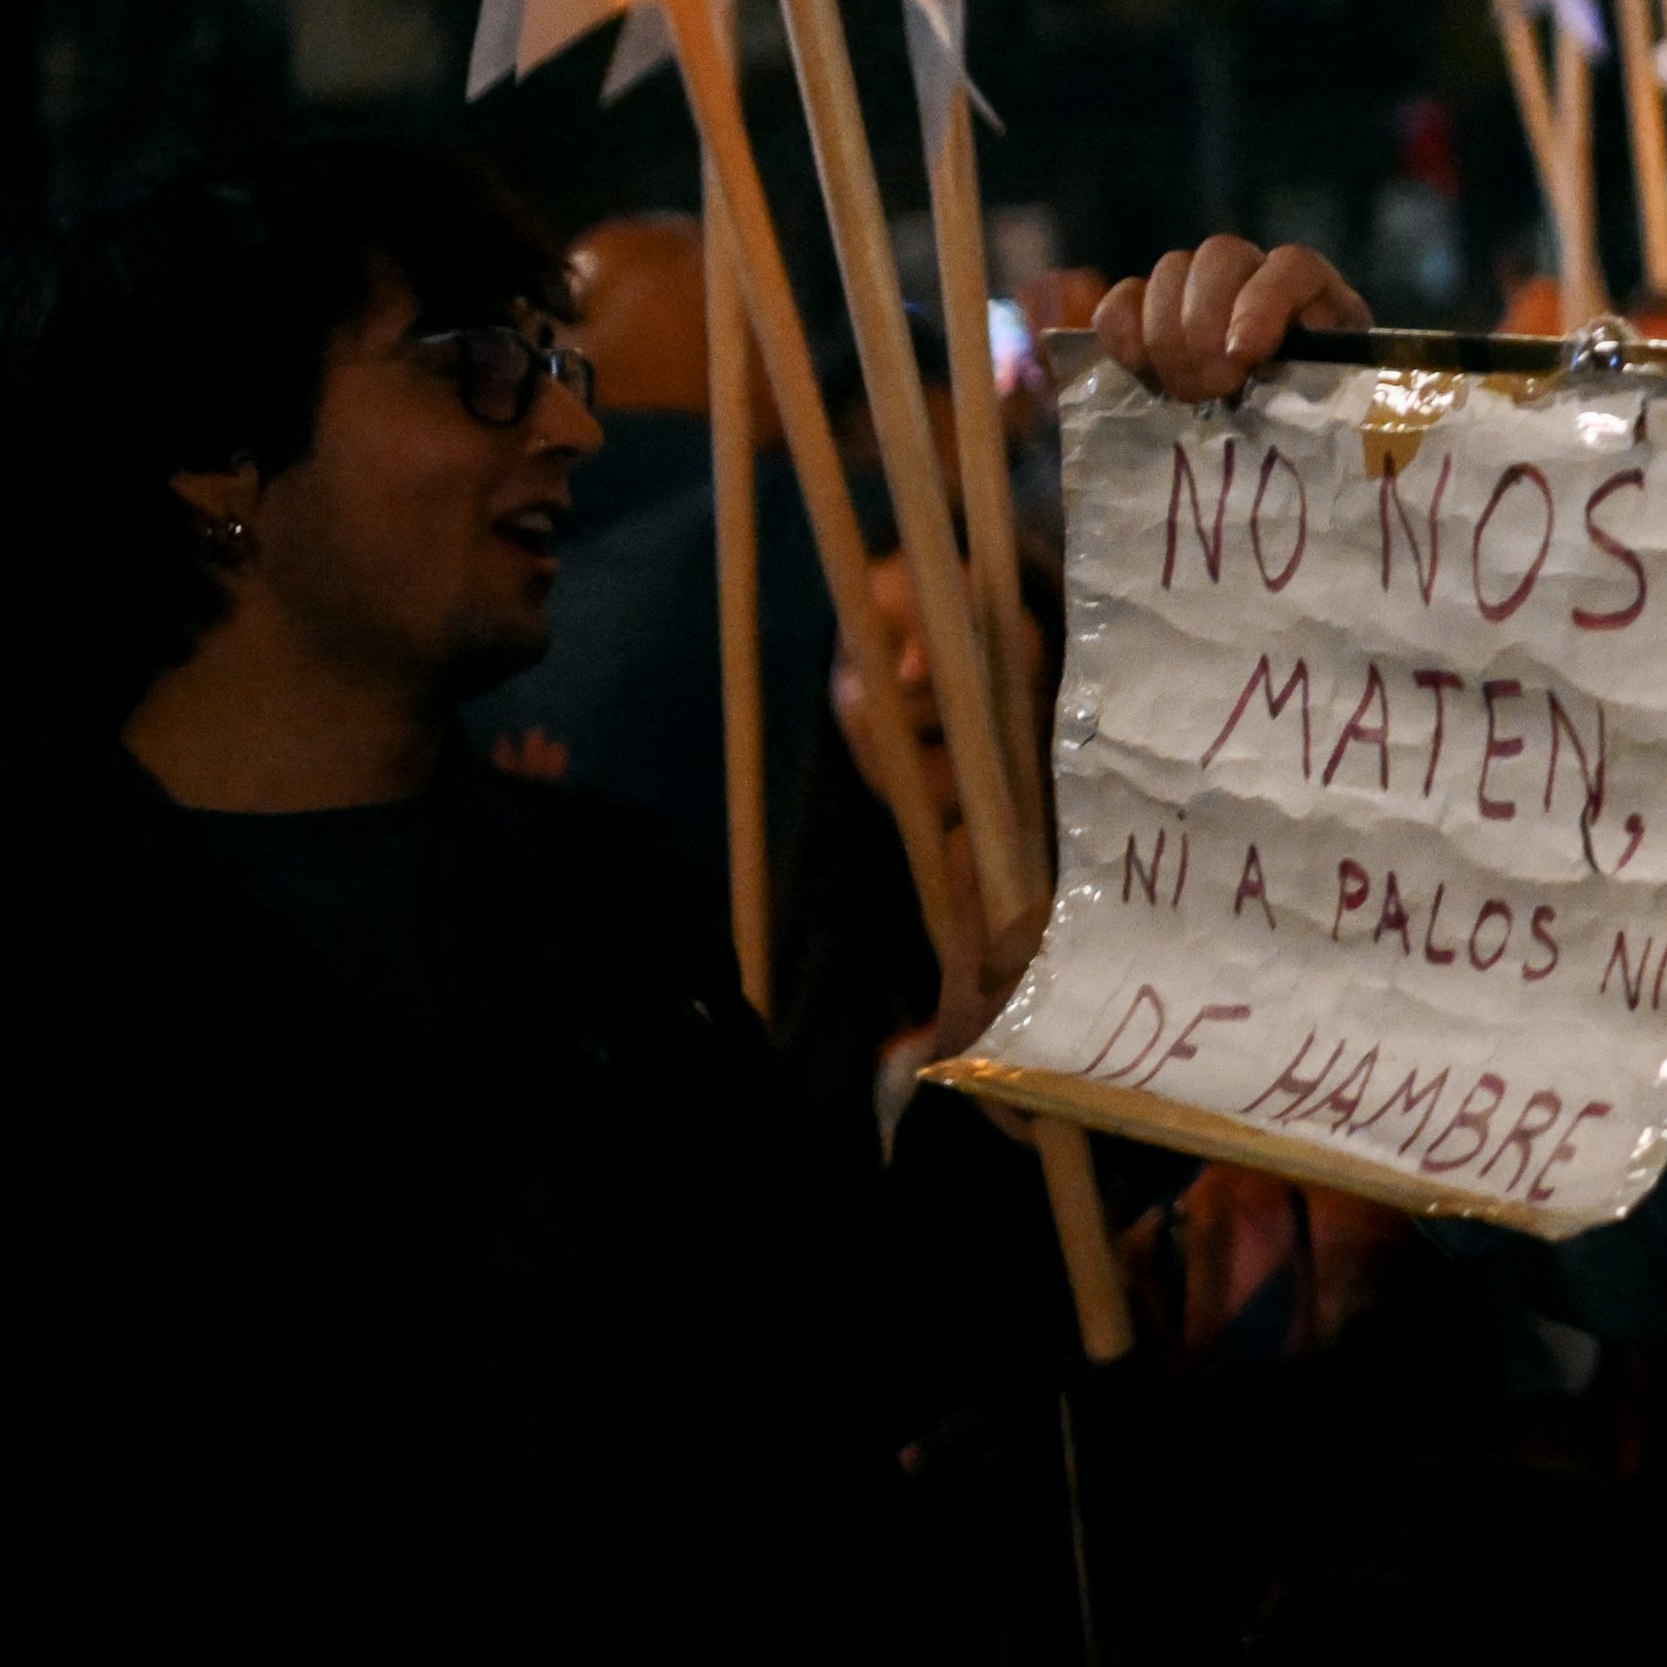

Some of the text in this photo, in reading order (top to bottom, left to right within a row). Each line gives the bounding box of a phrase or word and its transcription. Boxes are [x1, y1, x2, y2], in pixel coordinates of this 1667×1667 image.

[1162, 438, 1648, 631] NO NOS
[1201, 654, 1644, 872] MATEN,
[1234, 845, 1275, 929] A
[1332, 858, 1560, 982] PALOS
[1238, 1029, 1612, 1202] HAMBRE
